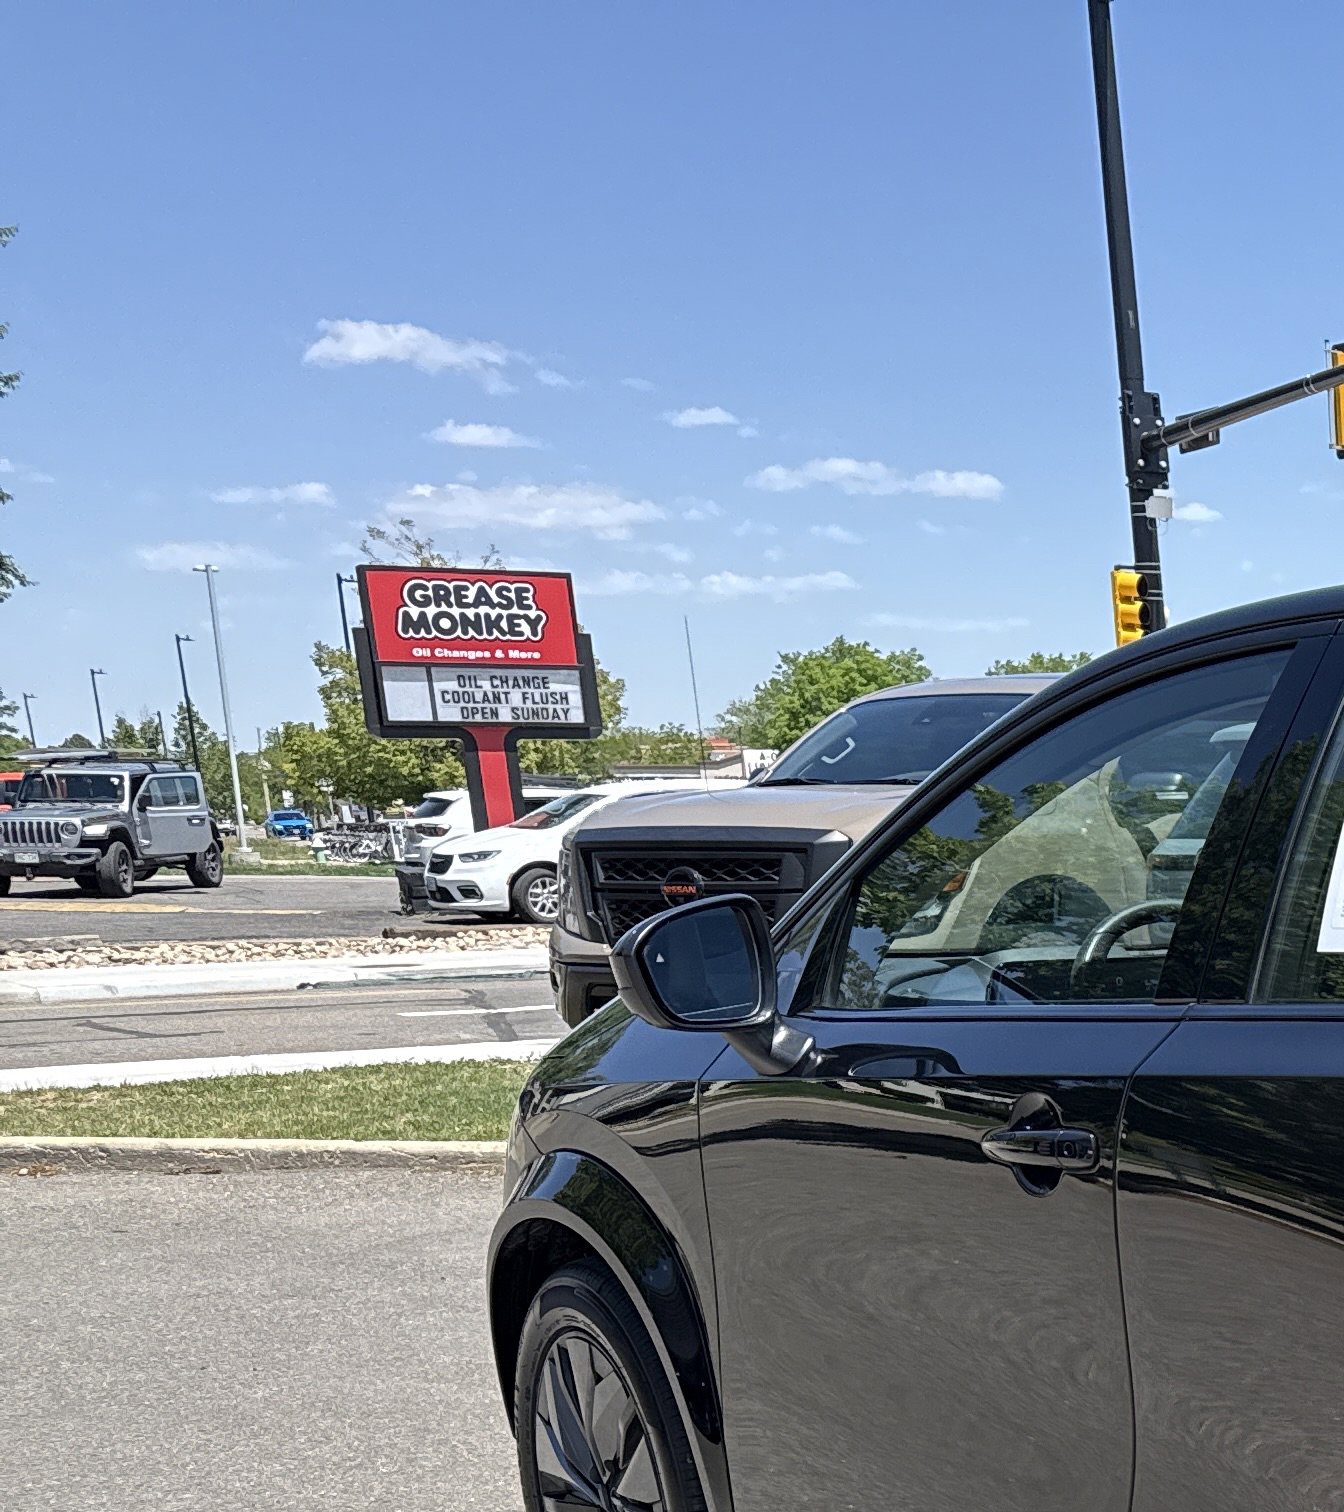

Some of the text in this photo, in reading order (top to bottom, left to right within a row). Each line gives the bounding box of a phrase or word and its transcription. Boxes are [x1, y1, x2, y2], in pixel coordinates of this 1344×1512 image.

[404, 581, 534, 611] GREASE
[400, 609, 544, 639] MONKEY
[412, 647, 542, 660] Oil Changes & More
[456, 674, 551, 690] OIL CHANGE
[440, 689, 570, 705] COOLANT FLUSH
[460, 706, 571, 721] OPEN SUNDAY
[662, 885, 696, 894] NISSAN
